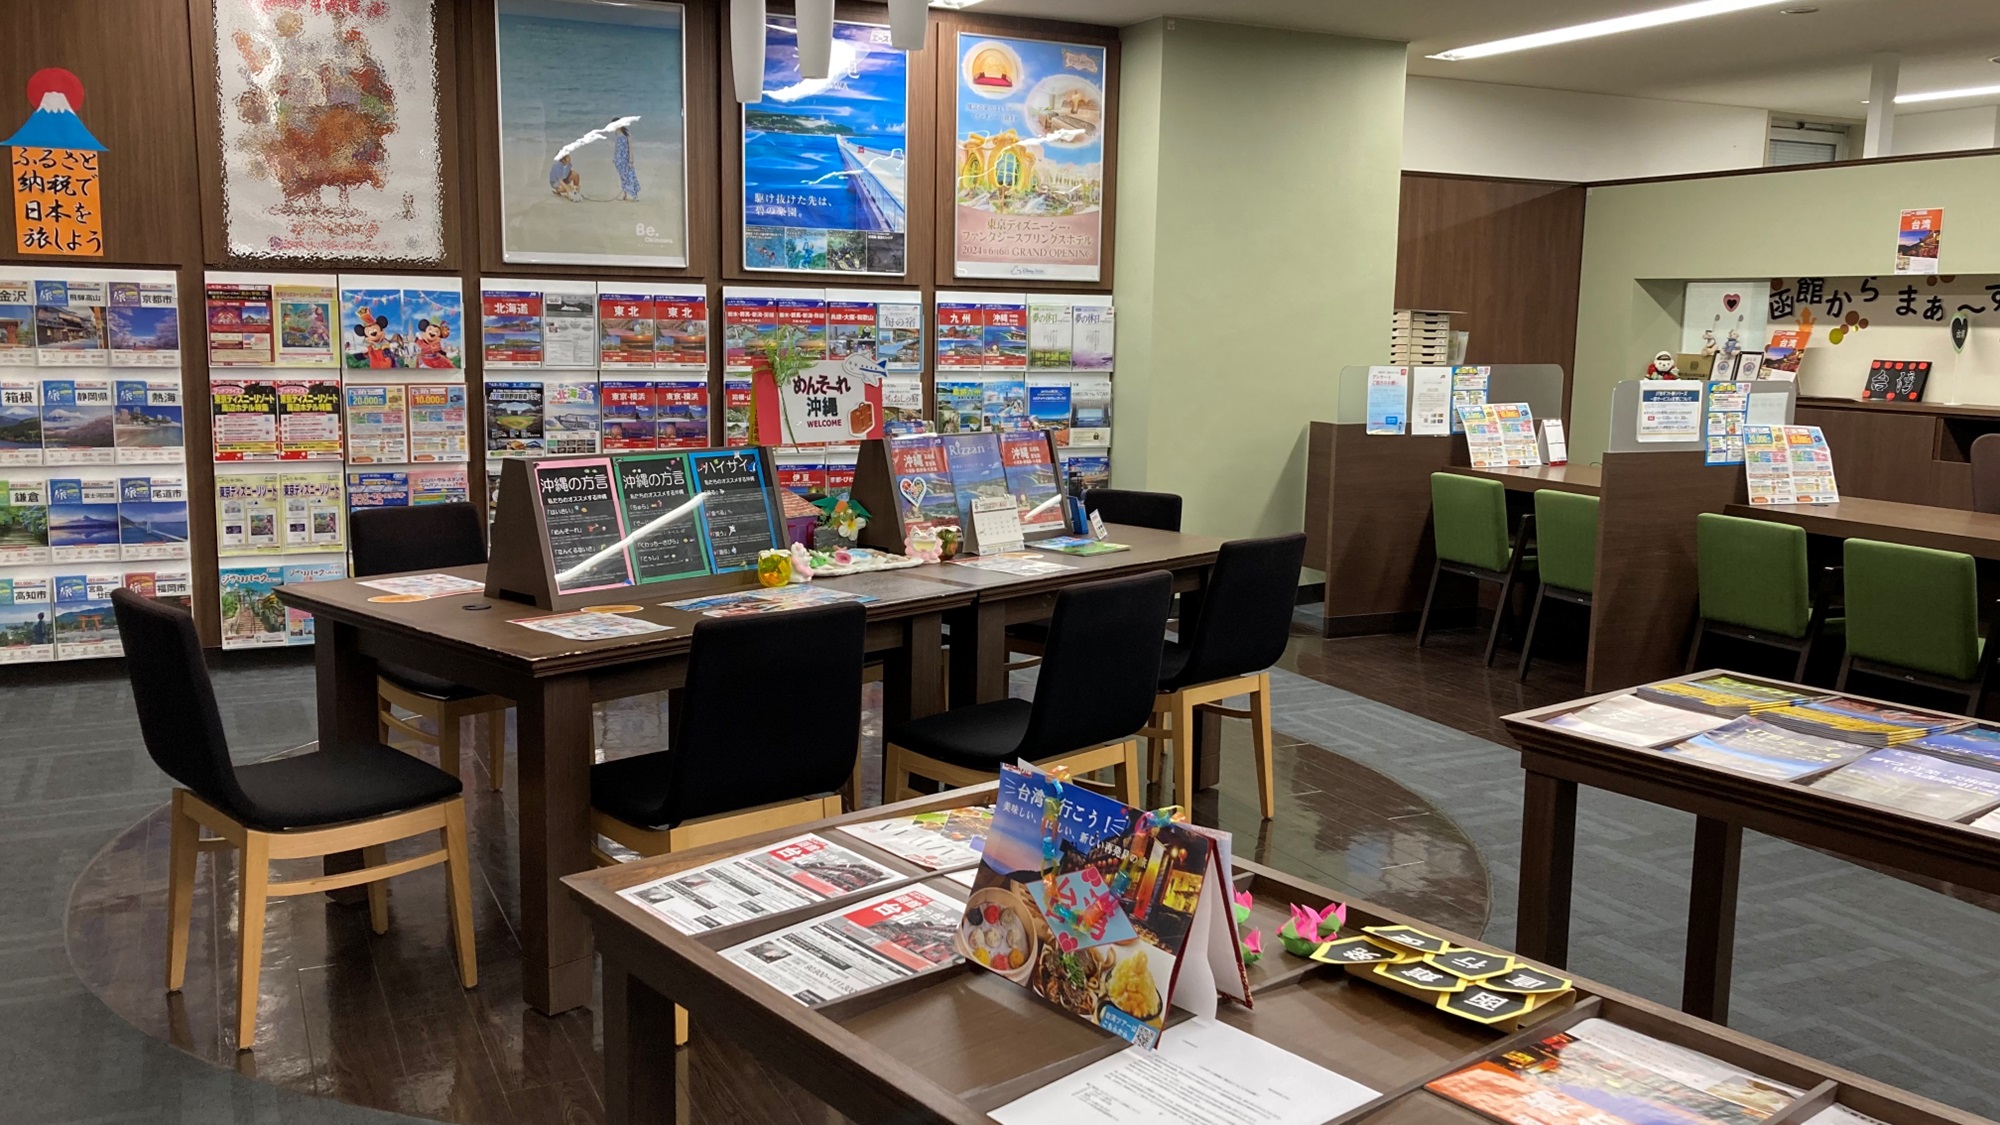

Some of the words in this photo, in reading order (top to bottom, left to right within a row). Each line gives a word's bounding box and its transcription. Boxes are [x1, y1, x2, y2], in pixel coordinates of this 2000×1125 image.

[13, 147, 97, 171] ふるさと
[17, 169, 98, 197] 納税で
[754, 193, 833, 207] 駆け抜けた先は、
[25, 199, 91, 224] 日本を
[636, 222, 659, 237] Be.
[1911, 219, 1931, 230] 台湾
[23, 226, 101, 253] 旅しよう
[962, 231, 1092, 245] ファンタジースプリングスホテル
[1012, 247, 1046, 257] GRAND
[1050, 249, 1092, 258] OPENING
[0, 290, 27, 302] 金沢
[142, 294, 173, 304] 京都市
[1769, 277, 1879, 320] 函館から
[494, 302, 529, 314] 北海道
[614, 306, 639, 317] 東北
[668, 307, 693, 318] 東北
[950, 313, 971, 323] 九州
[793, 375, 851, 395] めんそーれ
[5, 391, 33, 404] 箱根
[77, 392, 108, 401] 静岡県
[152, 392, 176, 403] 熱海
[807, 397, 838, 417] 沖縄
[807, 419, 842, 428] WELCOME
[540, 474, 608, 493] 沖縄の方言
[623, 470, 685, 489] 沖縄の方言
[14, 491, 39, 503] 鎌倉
[152, 489, 182, 499] 尾道市
[157, 583, 187, 593] 福岡市
[15, 590, 47, 601] 高知市
[1018, 783, 1112, 833] 台湾行こう！
[872, 902, 923, 926] 台北
[1104, 1011, 1138, 1033] 台湾ツアーは
